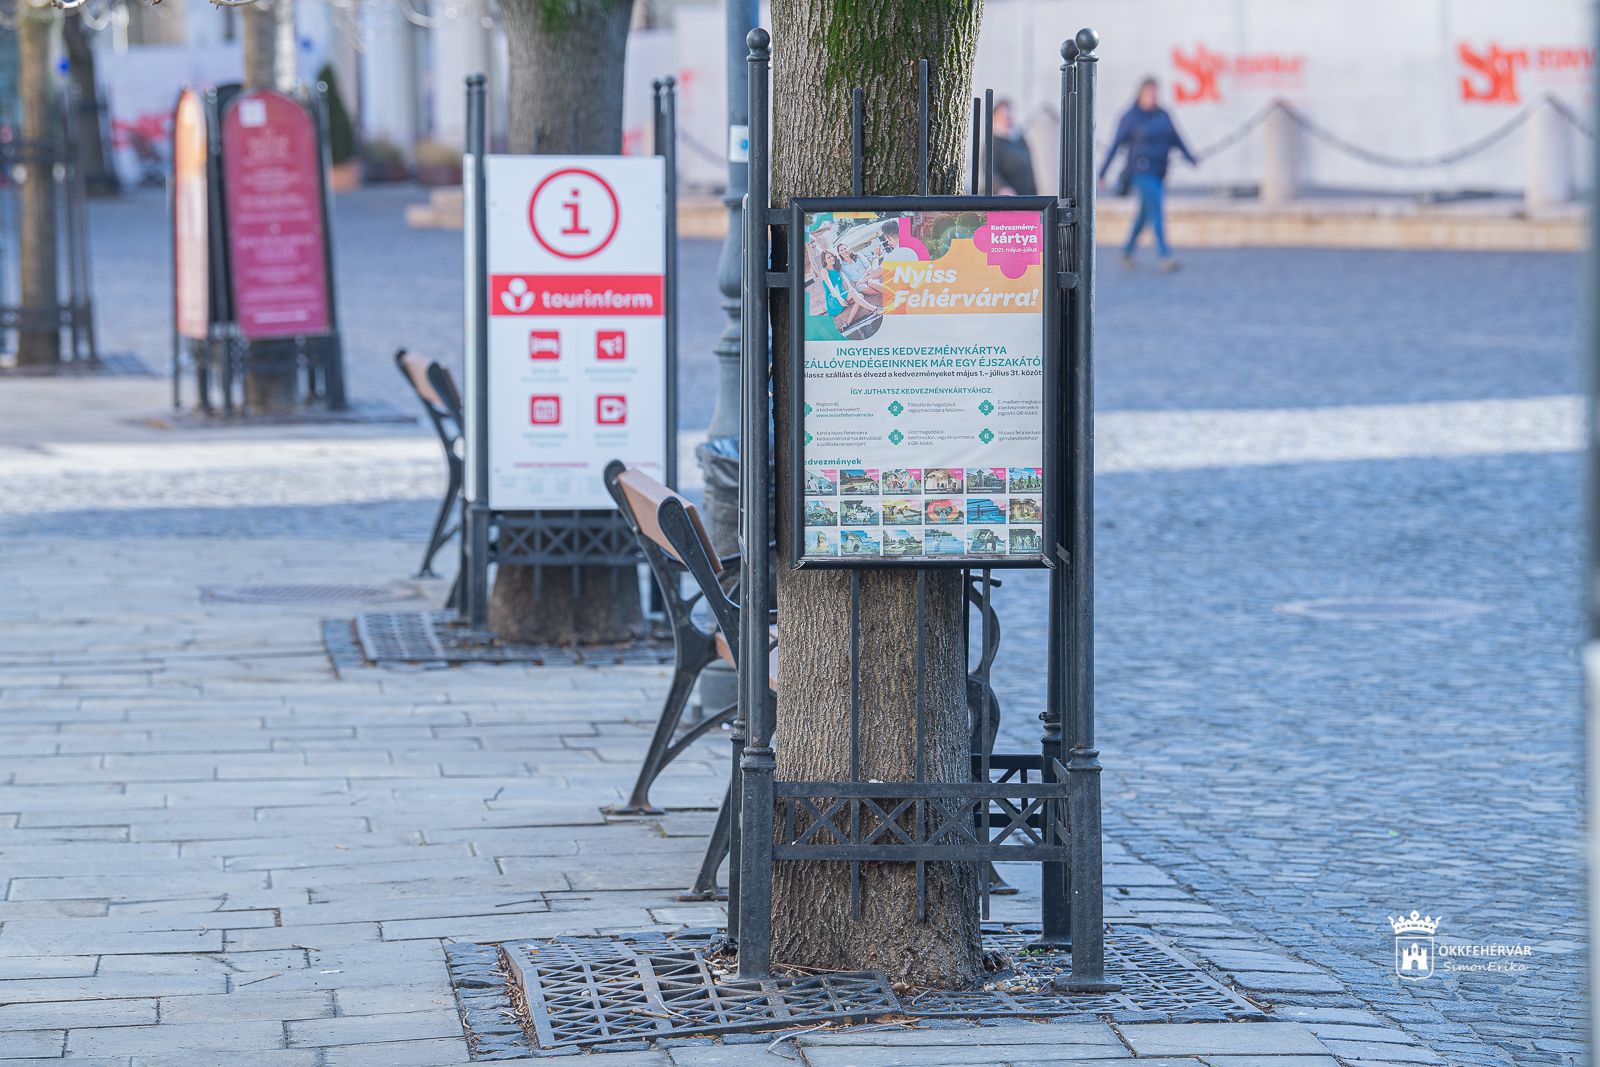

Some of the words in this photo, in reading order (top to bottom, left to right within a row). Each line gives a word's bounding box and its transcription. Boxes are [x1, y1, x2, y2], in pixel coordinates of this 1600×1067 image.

[991, 231, 1038, 246] kártya
[893, 263, 957, 289] Nyiss
[541, 288, 654, 308] tourinform
[893, 287, 1039, 309] Fehérvárra!
[836, 347, 891, 356] INGYENES
[892, 344, 1007, 356] KEDVEZMÉNYKÁRTYA
[930, 356, 953, 368] MÁR
[955, 358, 977, 367] EGY
[893, 370, 956, 379] kedvezményeket
[956, 370, 978, 379] május
[989, 369, 1009, 378] július
[1010, 369, 1020, 377] 31.
[850, 387, 862, 395] ÍGY
[901, 386, 993, 395] KEDVEZMÉNYKÁRTYÁHOZ:
